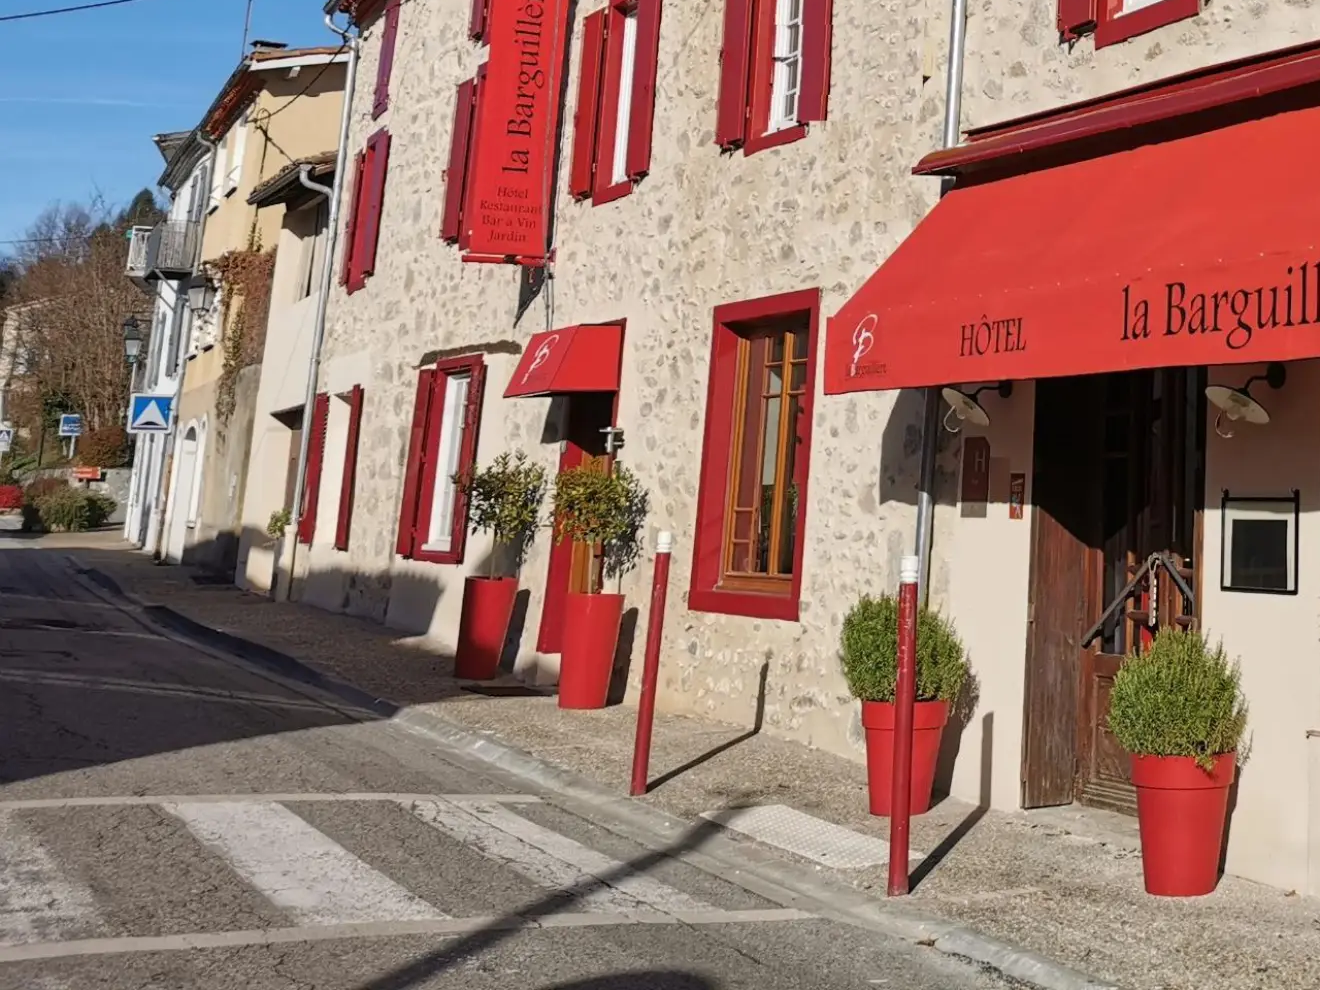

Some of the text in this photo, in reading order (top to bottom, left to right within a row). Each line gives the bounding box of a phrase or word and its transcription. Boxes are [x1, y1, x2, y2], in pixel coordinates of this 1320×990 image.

[501, 148, 530, 174] la
[482, 214, 503, 227] Bar
[517, 217, 537, 229] Vin
[487, 229, 527, 243] Jardin
[1120, 284, 1151, 341] la
[959, 313, 1027, 357] HÔTEL
